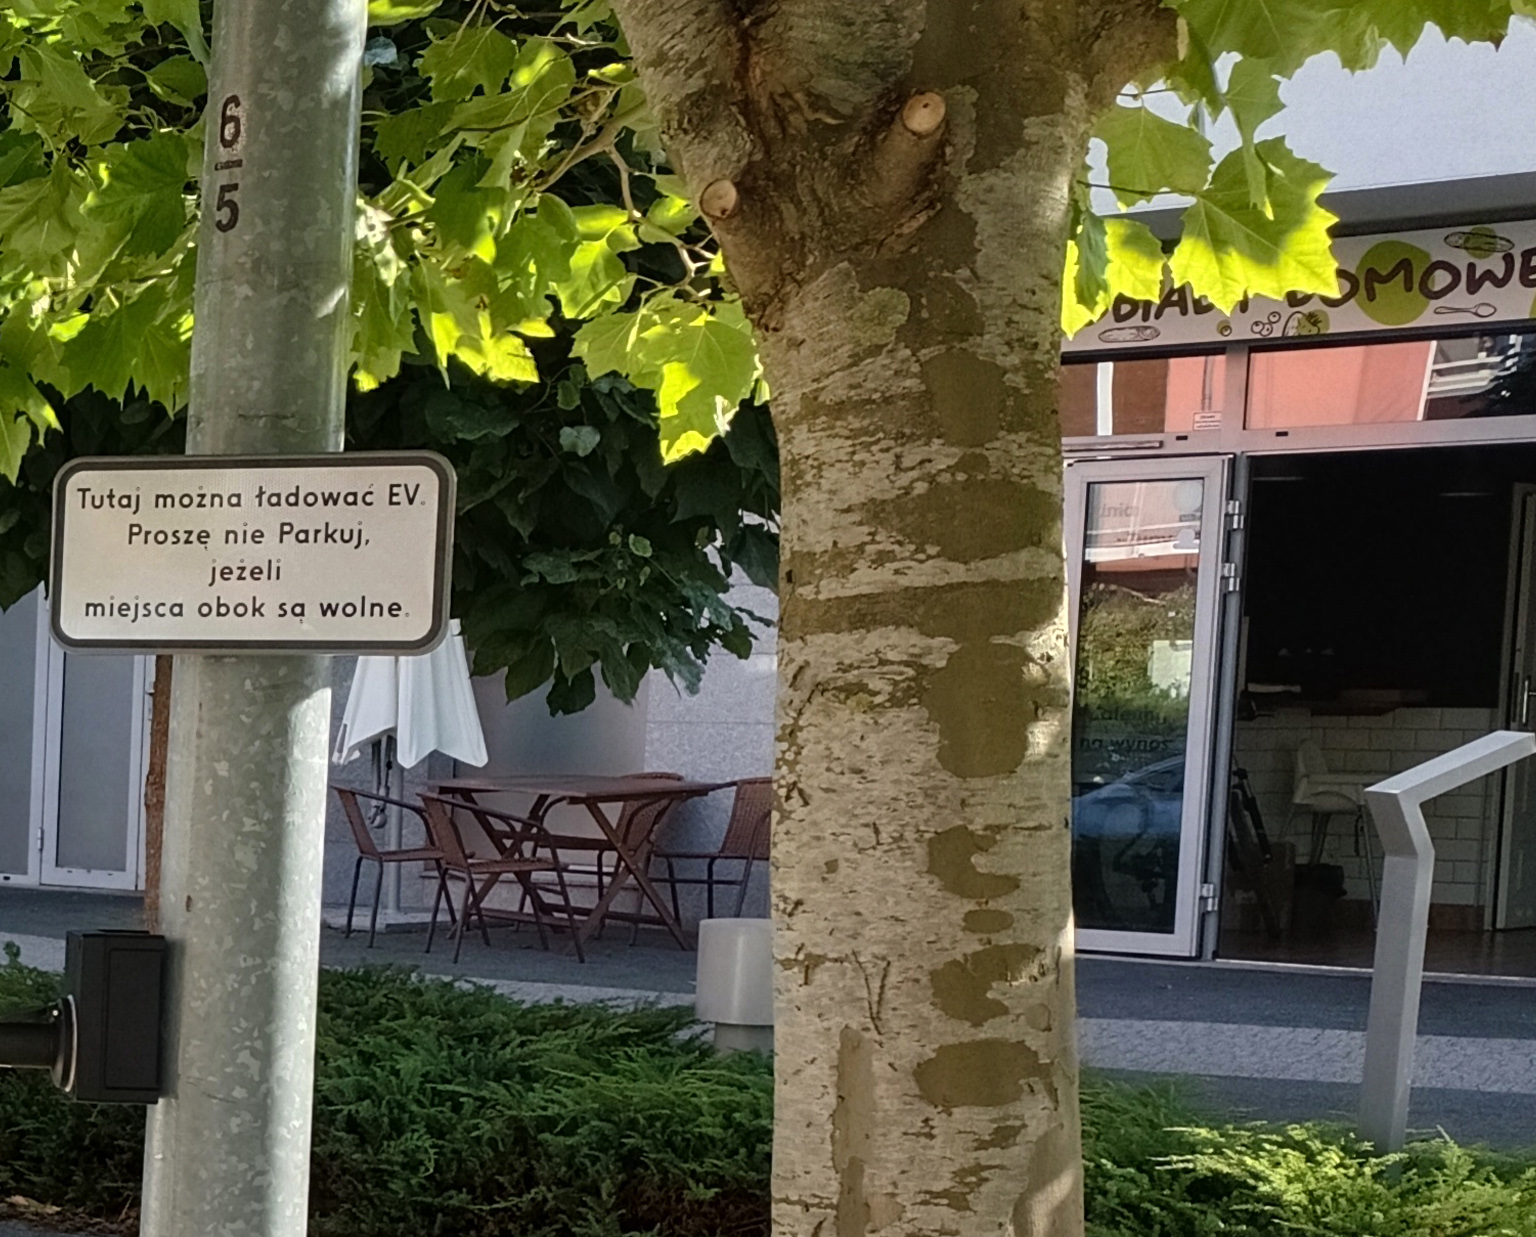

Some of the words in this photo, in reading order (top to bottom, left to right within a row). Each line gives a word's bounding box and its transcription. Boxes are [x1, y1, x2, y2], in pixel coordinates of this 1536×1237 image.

[219, 94, 241, 149] 6
[215, 182, 240, 233] 5
[76, 486, 141, 514] Tutaj
[154, 485, 243, 509] można
[255, 484, 374, 508] ładować
[388, 483, 427, 507] EV.
[127, 523, 211, 551] Proszę
[224, 522, 265, 546] nie
[278, 521, 370, 549] Parkuj,
[208, 558, 282, 587] jeżeli
[84, 595, 184, 624] miejsca
[197, 596, 266, 619] obok
[277, 602, 306, 624] są
[319, 596, 411, 619] wolne.
